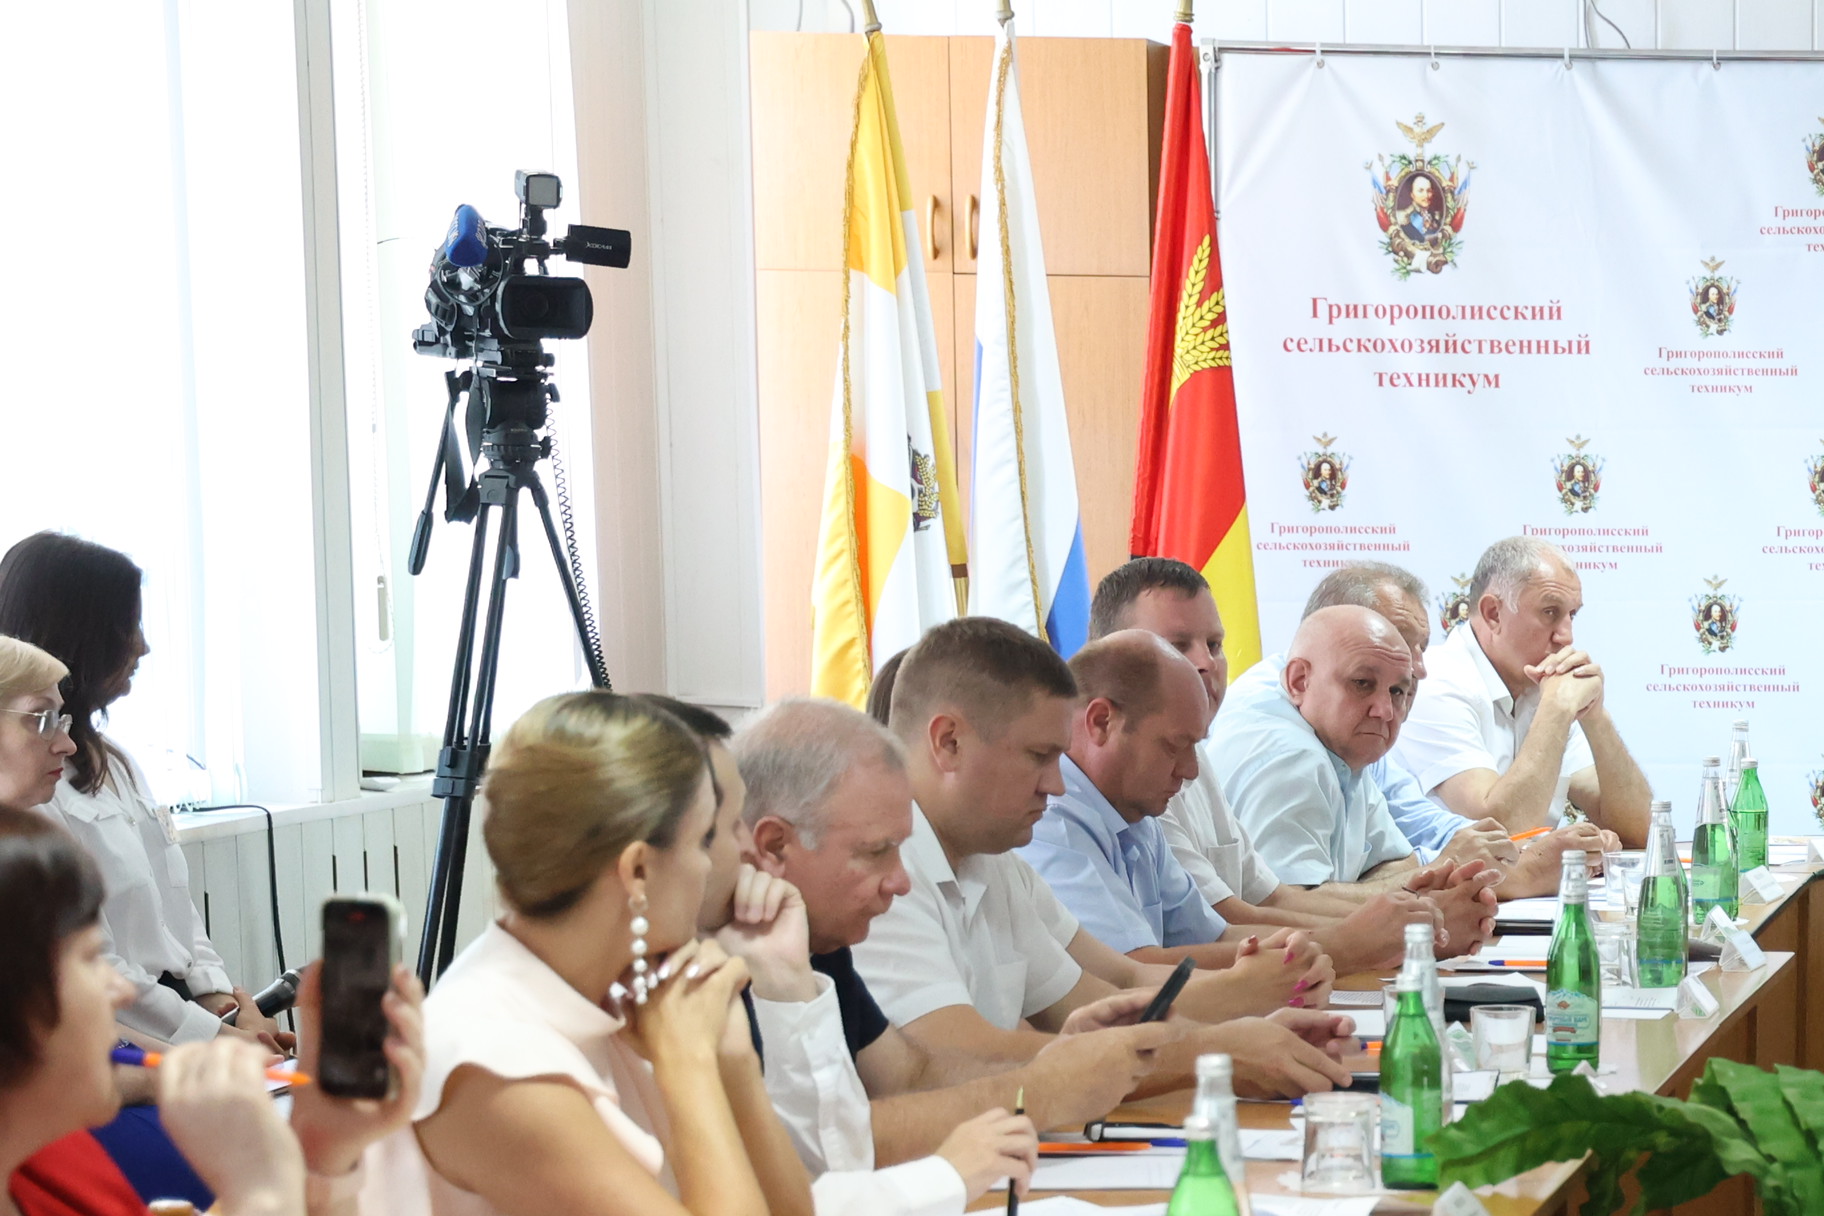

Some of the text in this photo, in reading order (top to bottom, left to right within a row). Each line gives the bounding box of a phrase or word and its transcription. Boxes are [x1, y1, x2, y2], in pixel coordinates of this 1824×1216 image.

[1310, 296, 1563, 326] Григорополисский
[1282, 331, 1591, 356] сельскохозяйственный
[1658, 347, 1784, 362] Григорополисский
[1644, 363, 1798, 376] сельскохозяйственный
[1374, 370, 1501, 394] техникум
[1690, 383, 1753, 396] техникум
[1270, 522, 1397, 537] Григорополисский
[1256, 540, 1411, 551] сельскохозяйственный
[1561, 542, 1663, 553] хозяйственный
[1576, 559, 1618, 573] никум
[1660, 664, 1786, 678] Григорополисский
[1646, 681, 1800, 692] сельскохозяйственный
[1692, 700, 1755, 711] техникум
